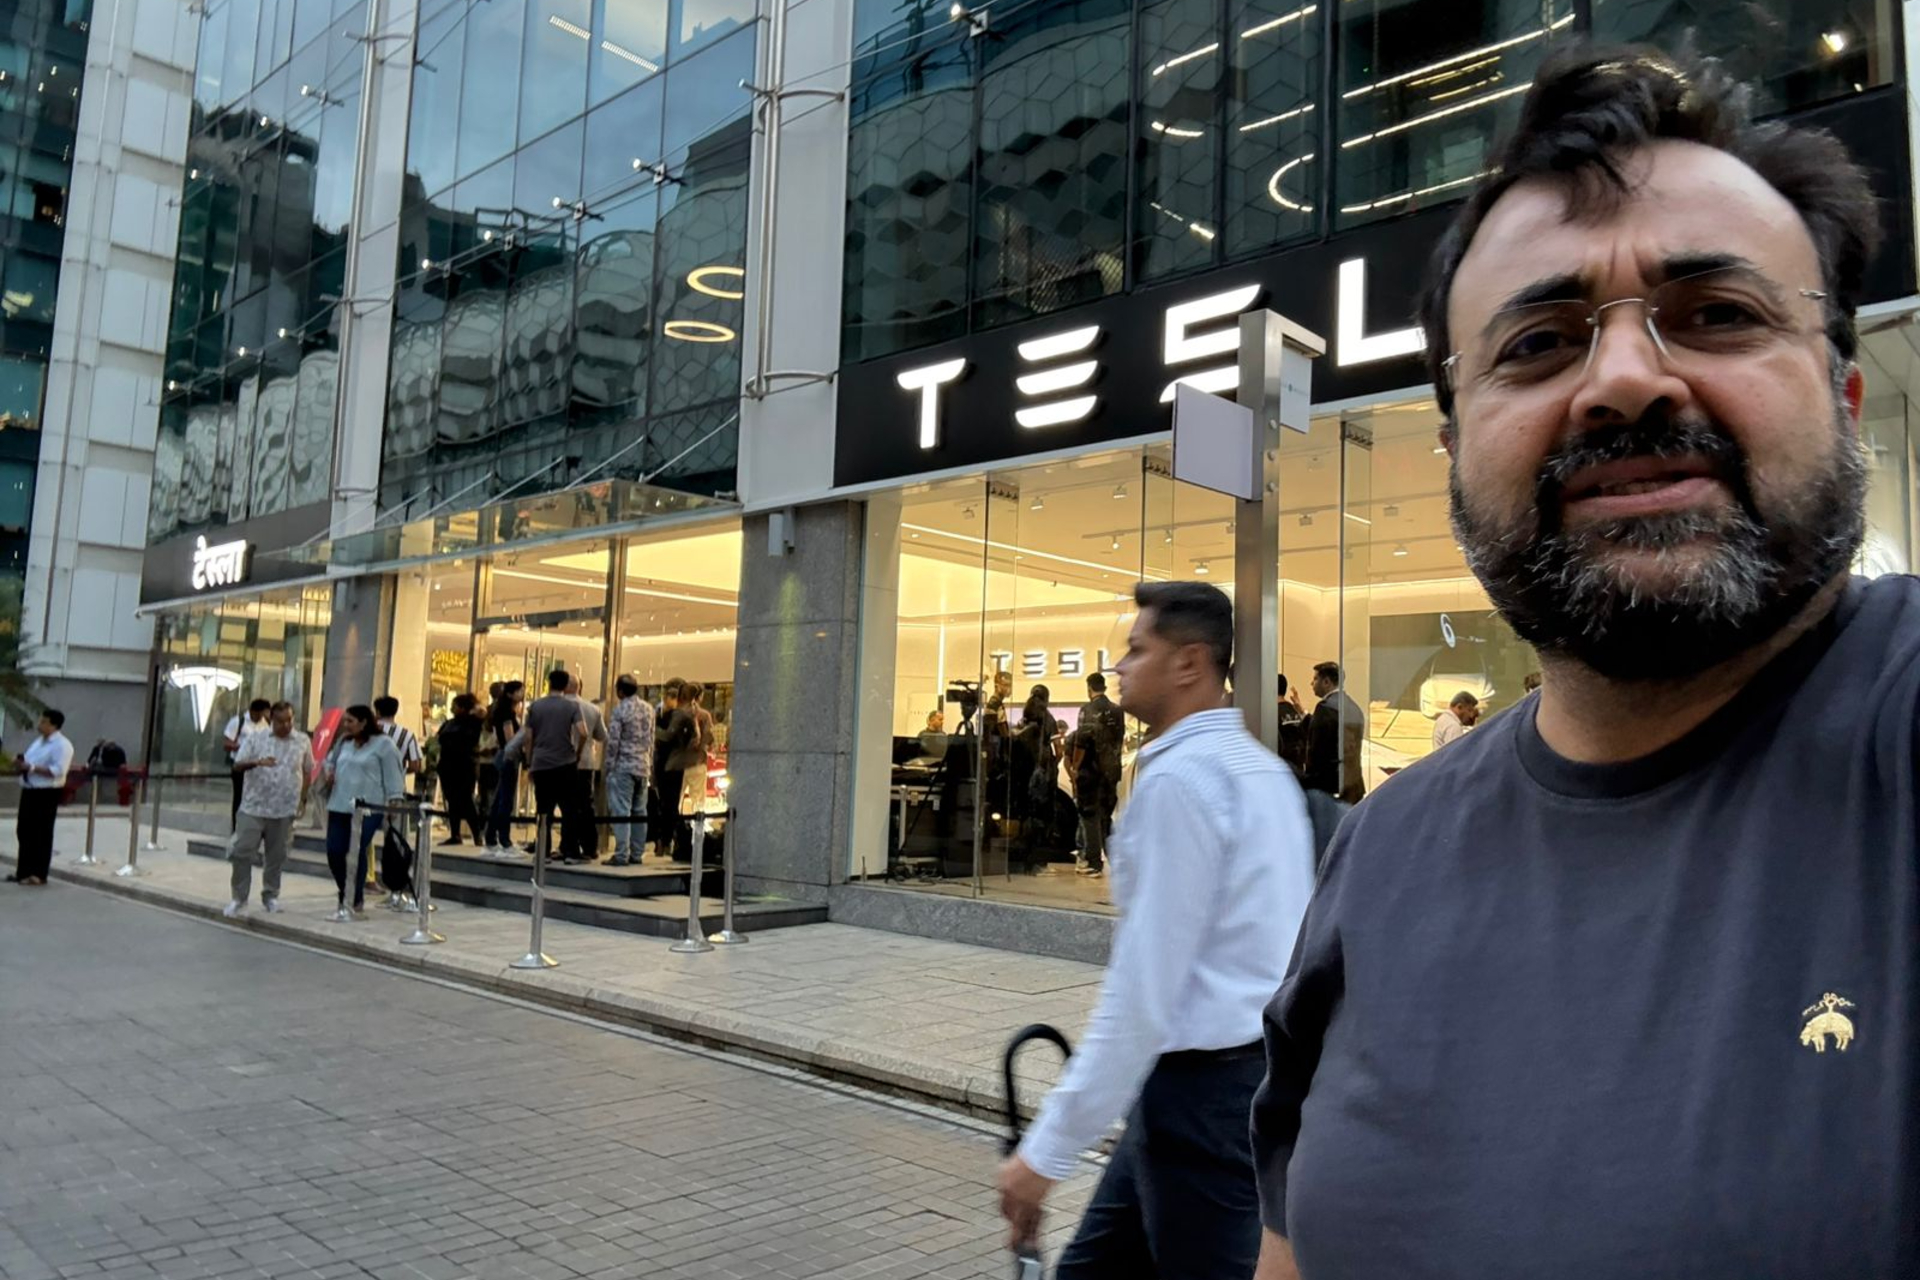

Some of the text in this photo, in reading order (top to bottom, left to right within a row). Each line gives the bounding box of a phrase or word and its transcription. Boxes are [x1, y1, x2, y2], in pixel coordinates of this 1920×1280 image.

[896, 257, 1428, 450] TESL
[192, 535, 248, 590] टेस्ला
[988, 647, 1119, 676] TESL
